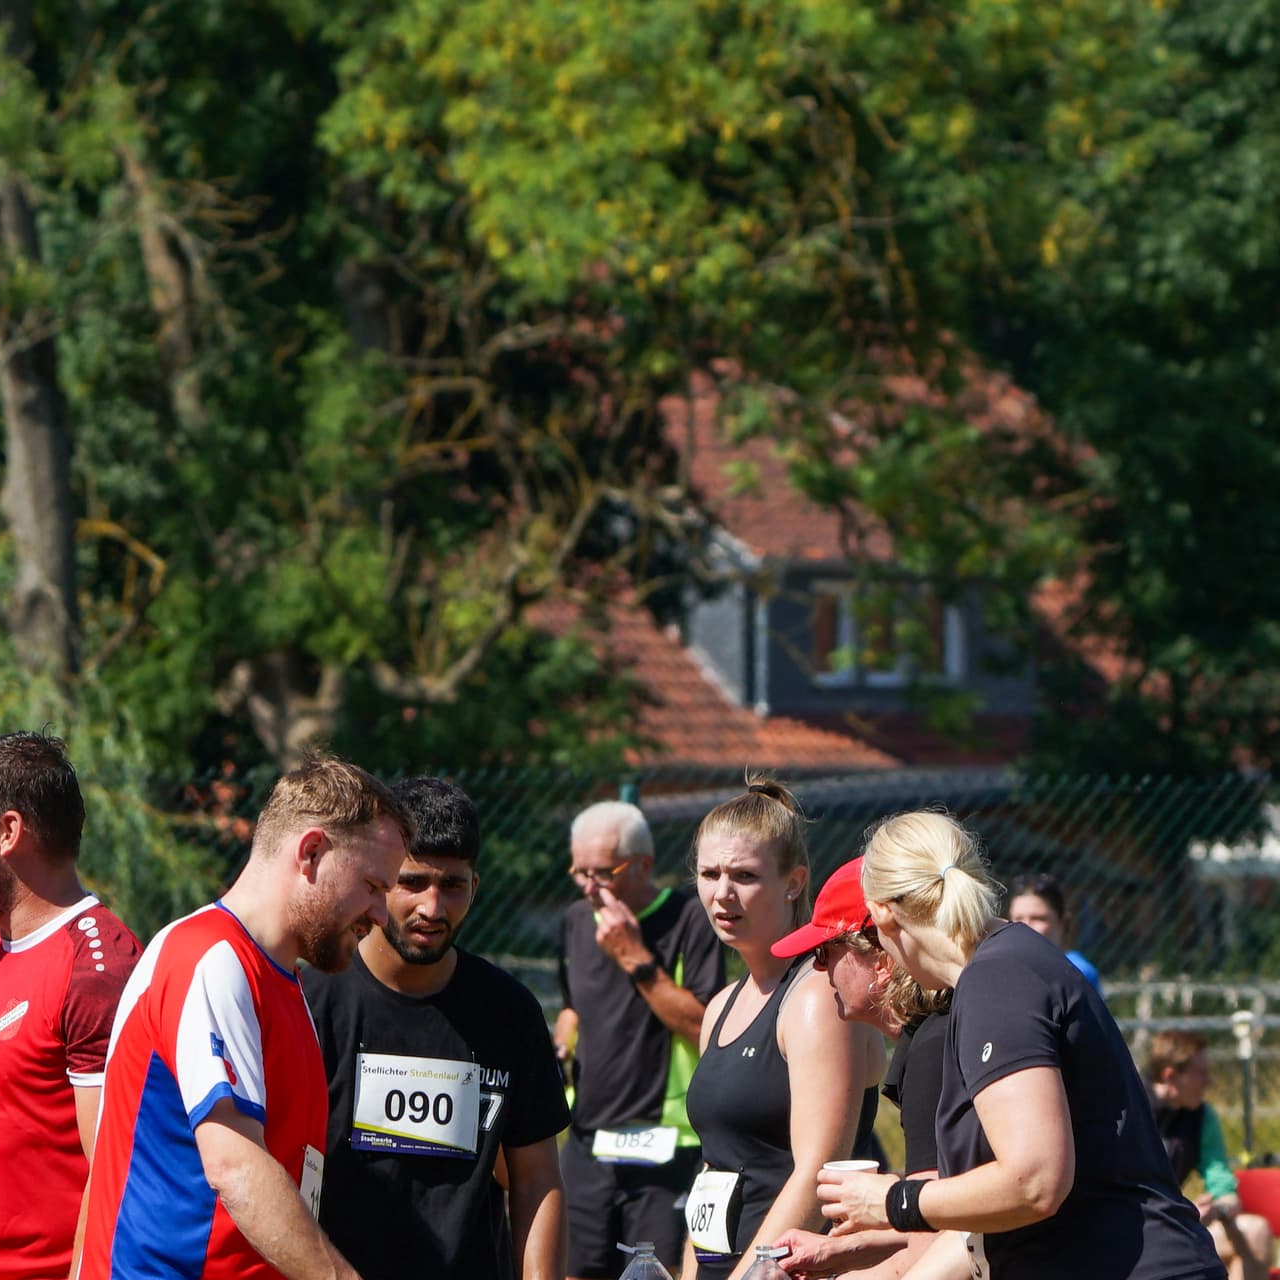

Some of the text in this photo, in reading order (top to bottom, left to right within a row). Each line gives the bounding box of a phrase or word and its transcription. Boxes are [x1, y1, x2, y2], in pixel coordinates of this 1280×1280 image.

[361, 1065, 460, 1081] Stellichter Straßenlauf
[384, 1088, 454, 1126] 090
[615, 1131, 655, 1149] 082
